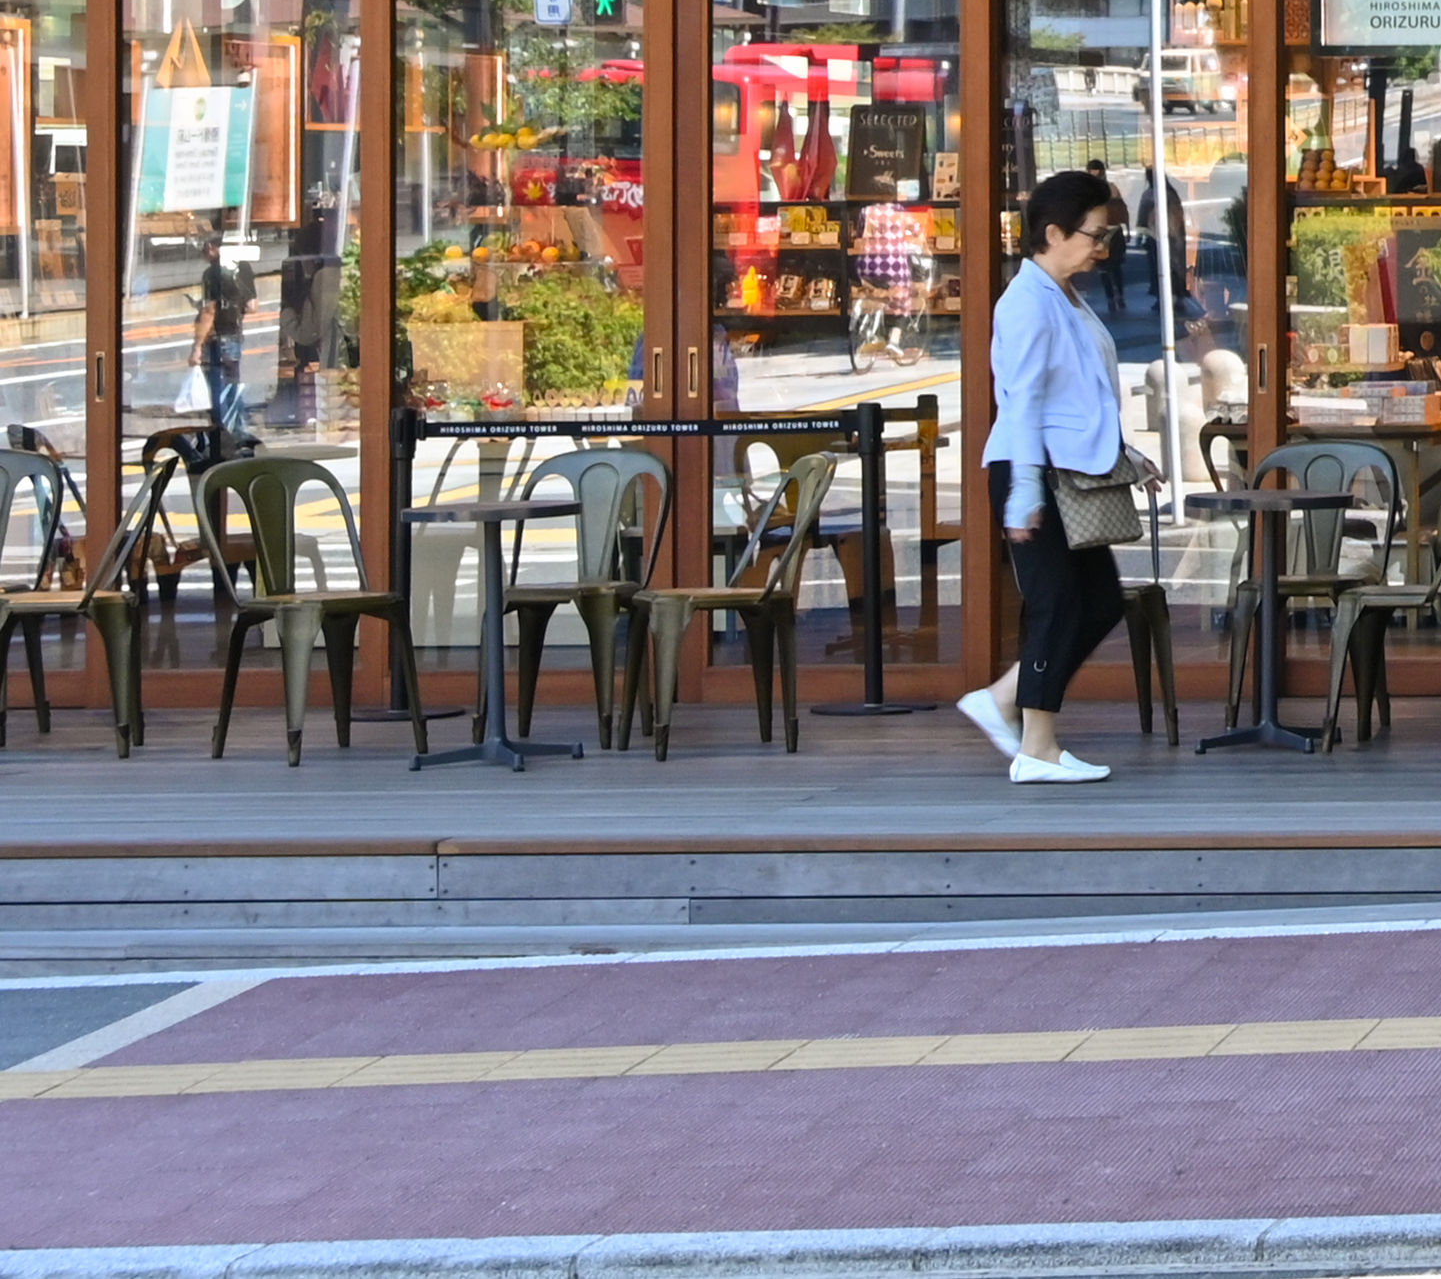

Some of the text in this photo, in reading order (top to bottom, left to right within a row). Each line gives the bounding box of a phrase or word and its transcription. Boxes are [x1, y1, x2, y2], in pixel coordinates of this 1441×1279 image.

[1370, 1, 1441, 11] HIROSHIMA
[1370, 15, 1441, 29] ORIZURU
[869, 143, 905, 160] Sweets
[439, 425, 558, 434] HIROSHIMA ORIZURU TOWER
[580, 423, 700, 433] HIROSHIMA ORIZURU TOWER
[722, 420, 840, 432] HIROSHIMA ORIZURU TOWER
